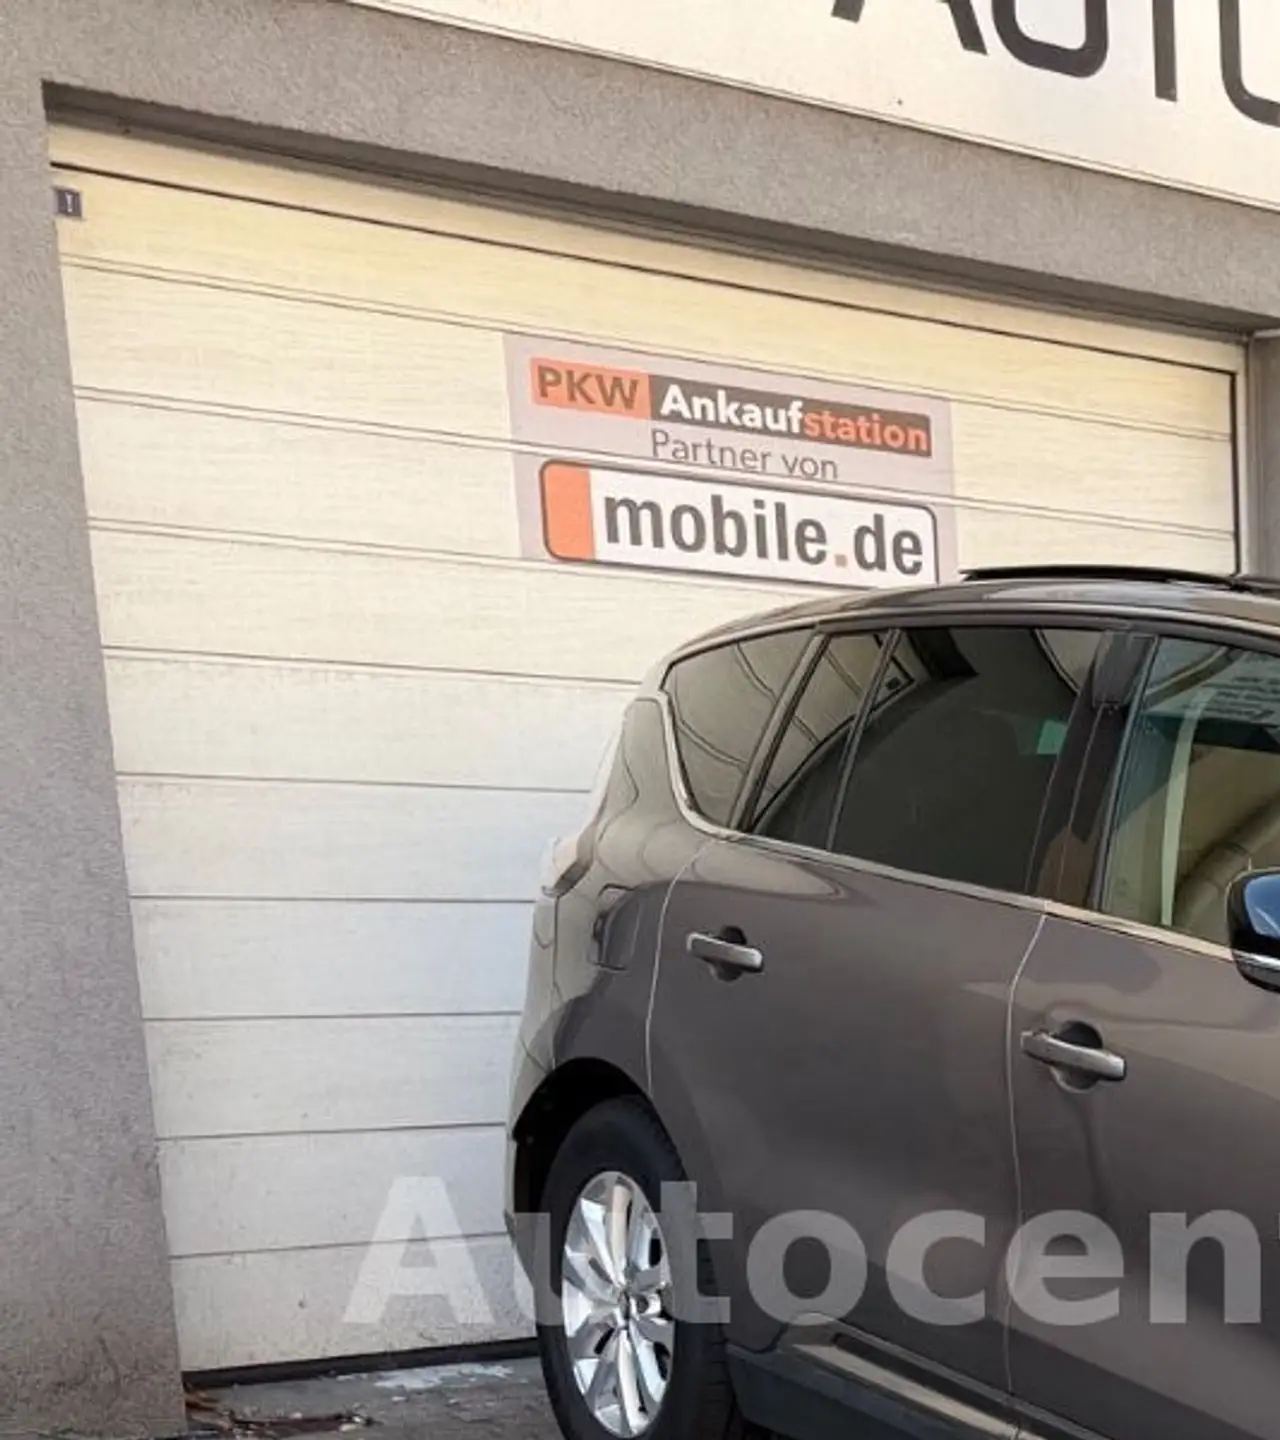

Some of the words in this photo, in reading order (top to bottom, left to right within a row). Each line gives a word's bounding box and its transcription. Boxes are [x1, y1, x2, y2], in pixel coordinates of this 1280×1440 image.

[537, 364, 640, 410] PKW
[660, 383, 929, 452] Ankaufstation
[651, 428, 771, 472] Partner
[781, 455, 839, 480] von
[604, 494, 924, 576] mobile.de
